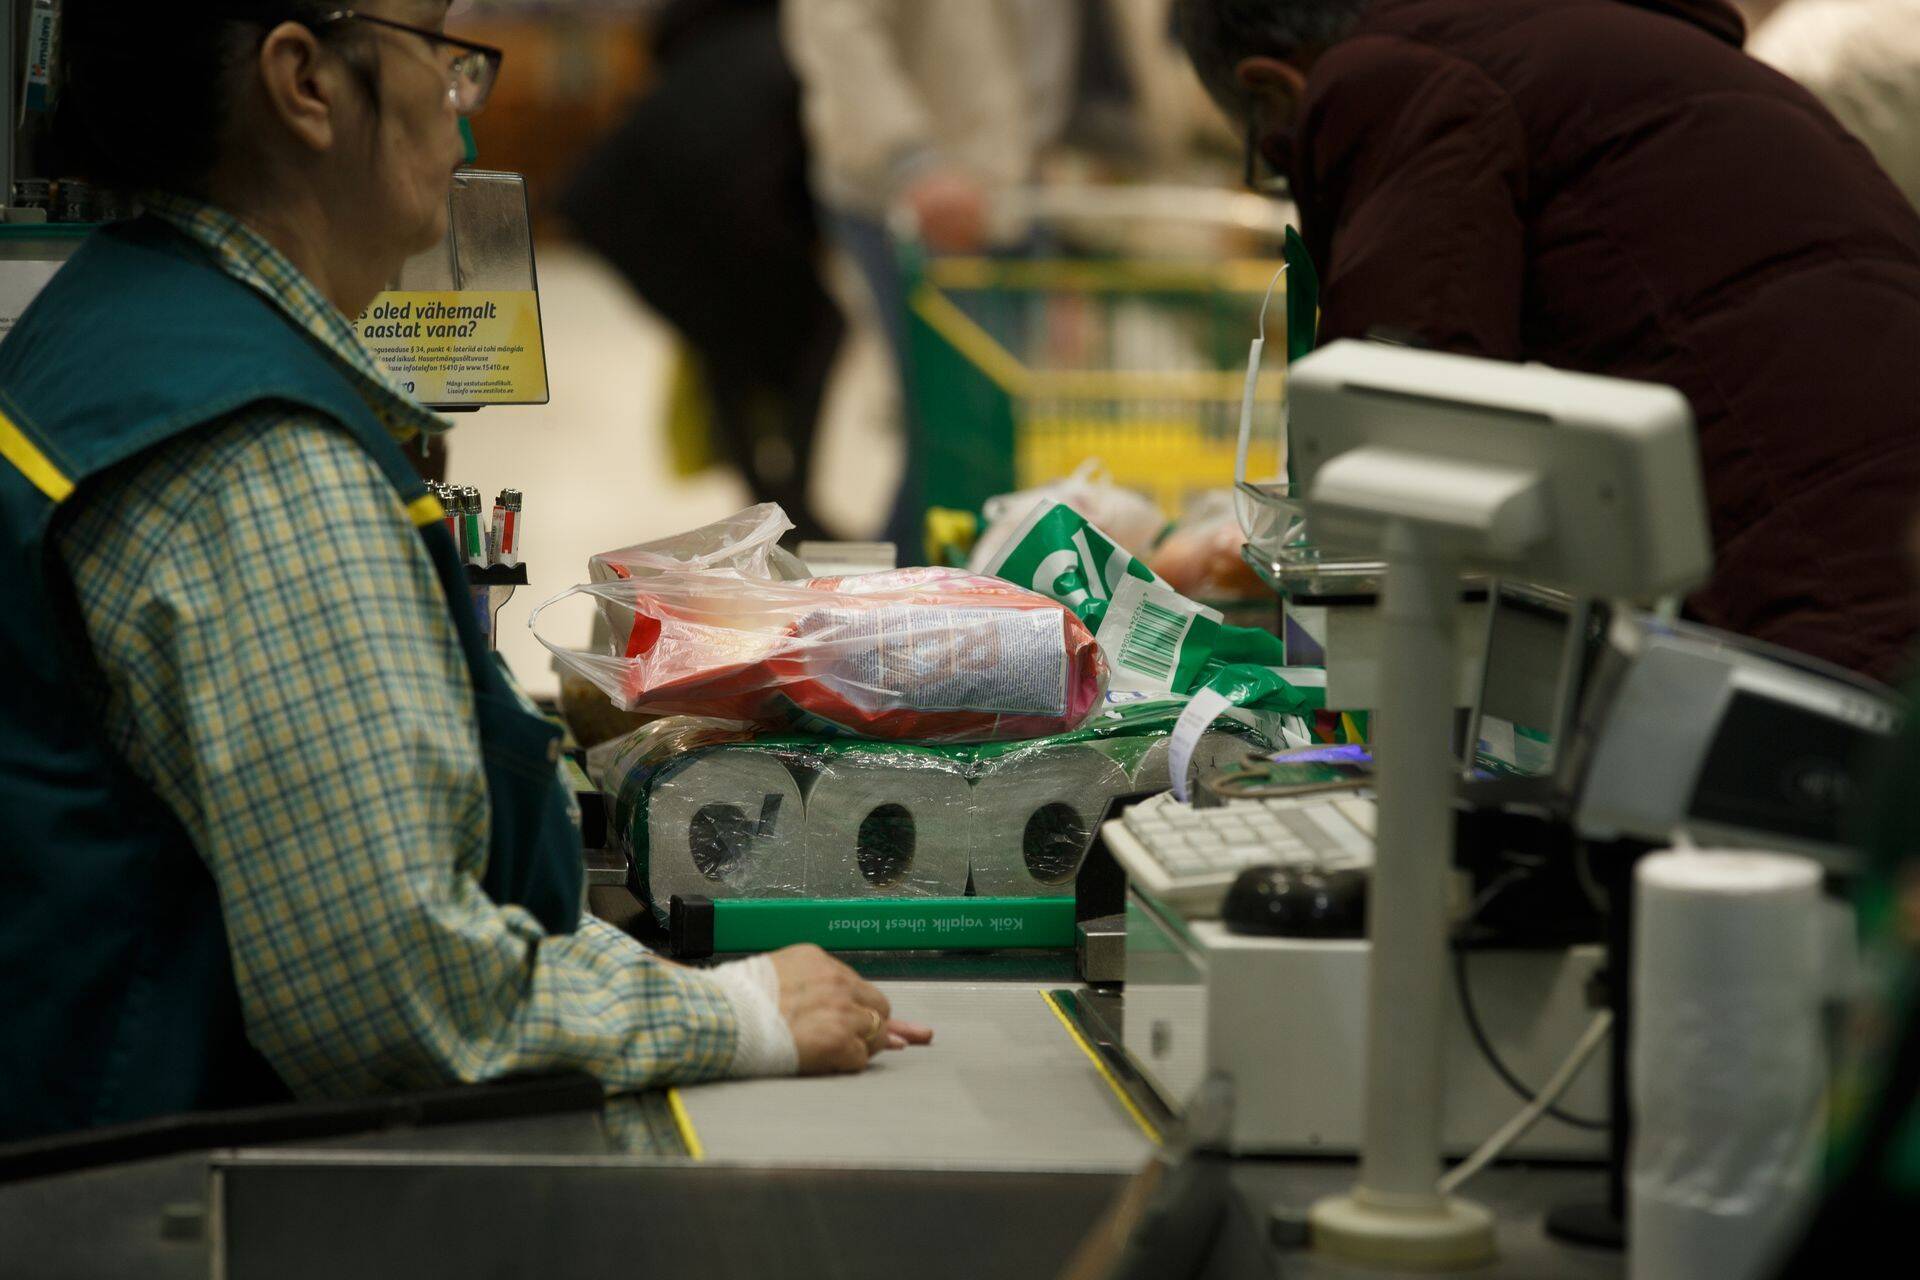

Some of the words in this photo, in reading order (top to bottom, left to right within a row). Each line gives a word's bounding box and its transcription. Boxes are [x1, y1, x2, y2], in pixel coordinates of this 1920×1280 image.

[373, 301, 411, 319] oled
[416, 301, 497, 319] vähemalt
[364, 321, 421, 338] aastat
[427, 320, 477, 338] vana?
[427, 346, 445, 355] punkt
[466, 363, 510, 371] www.15410.ee
[828, 917, 880, 933] kohast
[885, 917, 926, 933] ühest
[932, 914, 983, 932] vajalik
[989, 917, 1024, 932] Kõik
